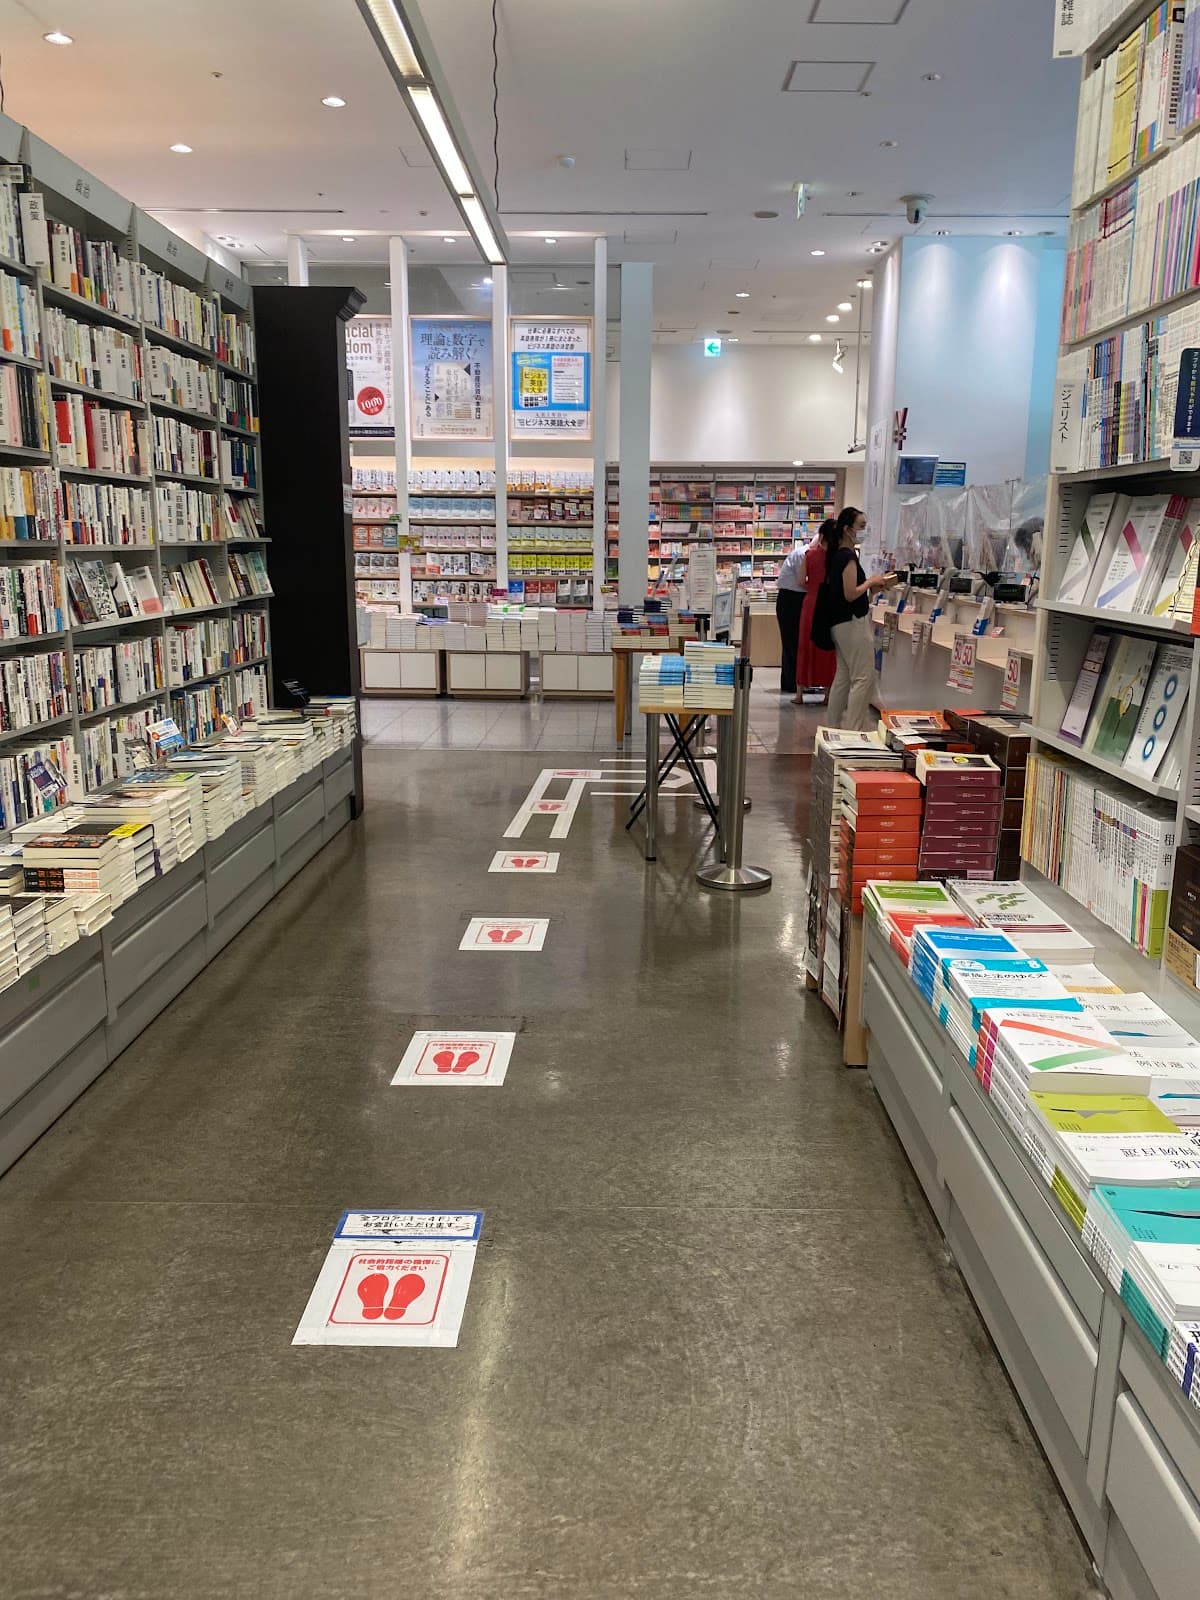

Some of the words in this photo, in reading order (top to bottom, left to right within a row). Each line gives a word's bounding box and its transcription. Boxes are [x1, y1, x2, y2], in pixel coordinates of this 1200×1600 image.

[420, 333, 485, 346] 理論と数字で
[525, 419, 577, 427] ビジネス英語大全
[1059, 389, 1072, 444] ジュリスト
[1007, 659, 1019, 682] 50
